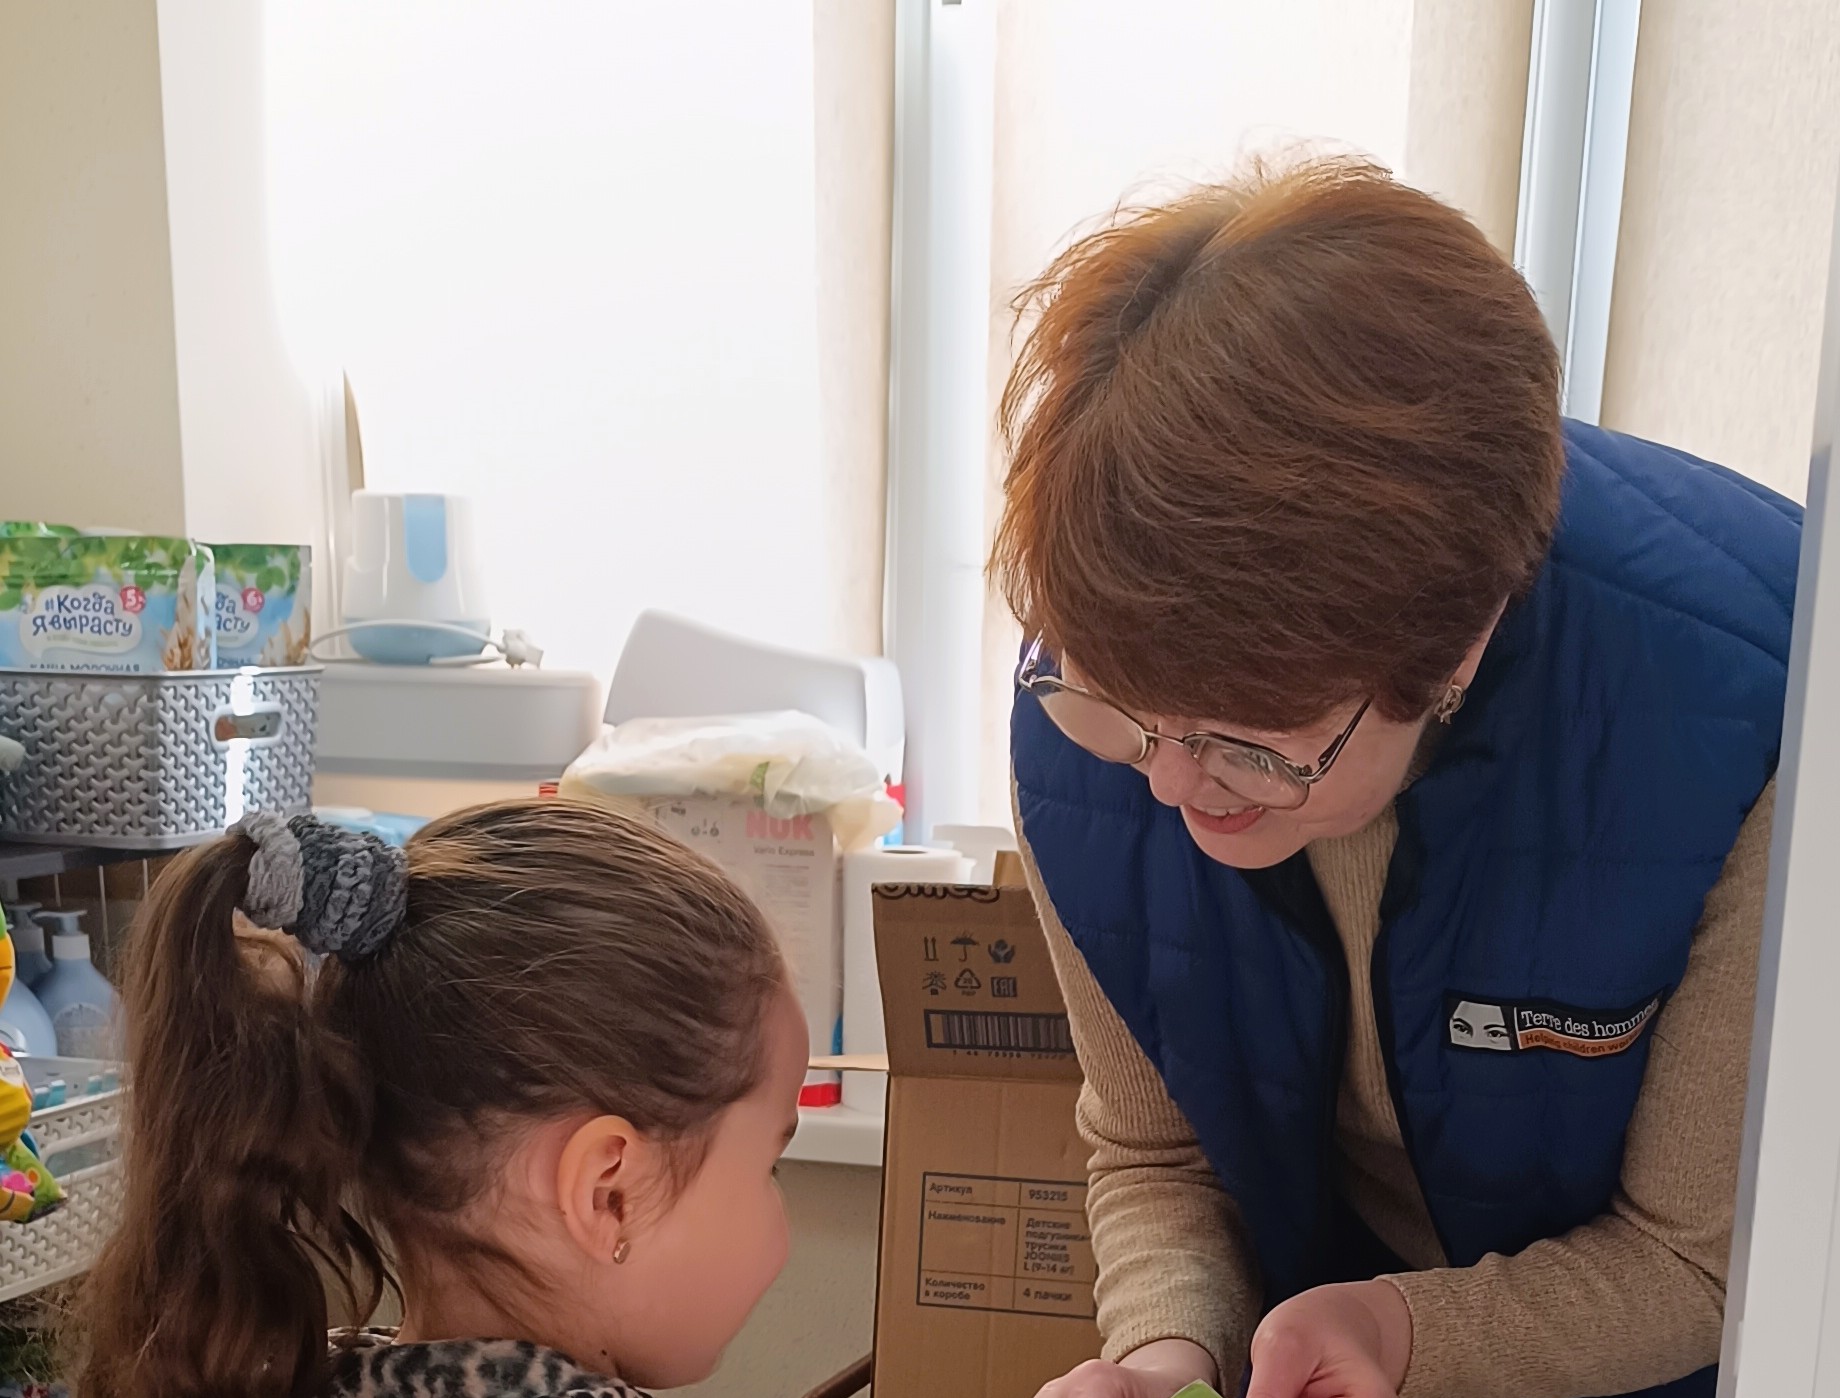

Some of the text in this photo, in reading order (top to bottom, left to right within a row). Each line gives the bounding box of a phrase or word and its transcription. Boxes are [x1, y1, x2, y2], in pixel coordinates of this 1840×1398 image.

[746, 811, 815, 841] NUK
[1521, 1011, 1561, 1030] Terre
[1565, 1018, 1590, 1036] des
[929, 1182, 973, 1196] Артикул
[925, 1278, 985, 1291] Количество
